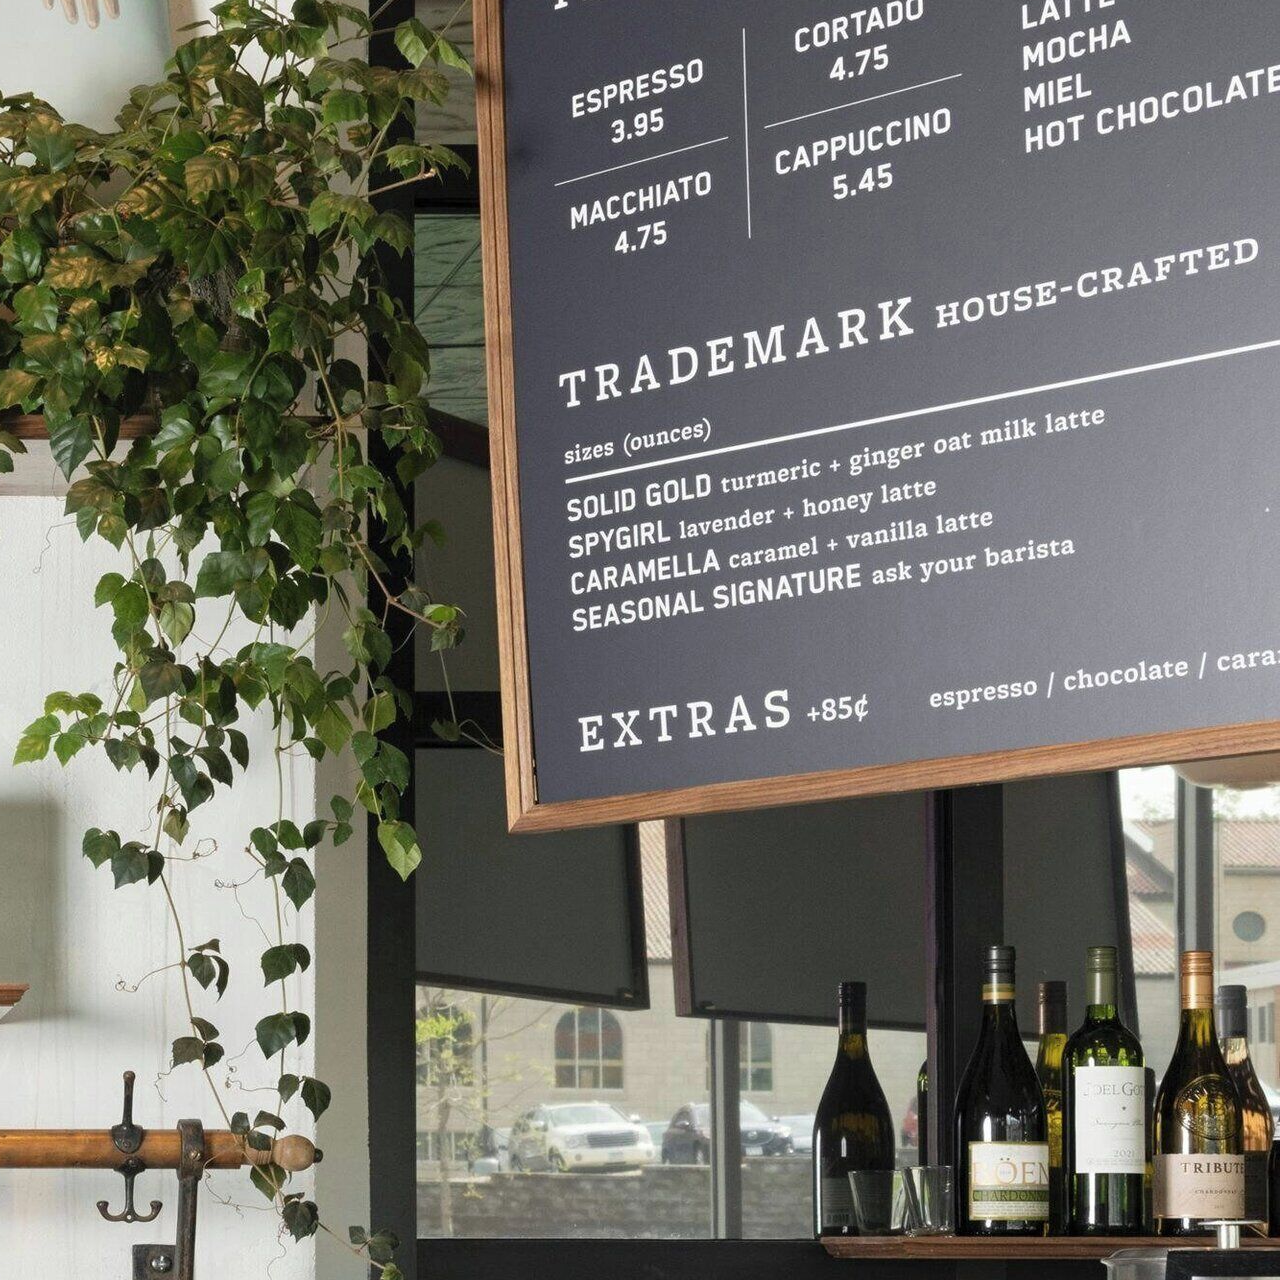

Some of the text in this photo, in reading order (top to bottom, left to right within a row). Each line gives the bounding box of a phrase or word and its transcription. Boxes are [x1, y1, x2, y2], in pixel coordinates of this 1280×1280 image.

[830, 44, 888, 80] 4.75
[1023, 20, 1131, 70] MOCHA
[572, 59, 703, 118] ESPRESSO
[1024, 73, 1091, 111] MIEL
[1025, 65, 1280, 153] HOT CHOCOLATE
[611, 108, 663, 143] 3.95
[776, 108, 950, 174] CAPPUCCINO
[571, 171, 711, 229] MACCHIATO
[833, 163, 892, 200] 5.45
[615, 221, 667, 254] 4.75
[559, 239, 1258, 408] TRADEMARK HOUSE-CRAFTED
[565, 418, 711, 464] sizes (ounces)
[567, 488, 635, 521] SOLID
[646, 474, 711, 506] GOLD
[721, 459, 820, 493] turmeric
[850, 442, 925, 476] ginger
[934, 433, 971, 453] oat
[981, 418, 1036, 445] milk
[1045, 409, 1105, 433] latte
[569, 520, 670, 558] SPYGIRL
[679, 509, 775, 538] lavender
[802, 492, 873, 517] honey
[881, 481, 936, 503] latte
[571, 549, 720, 594] CARAMELLA
[729, 536, 818, 568] caramel
[846, 520, 928, 548] vanilla
[936, 512, 993, 534] latte
[573, 540, 1075, 631] SEASONAL SIGNATURE ask your barista
[578, 689, 790, 752] EXTRAS
[807, 694, 868, 722] +85¢
[930, 681, 1037, 710] espresso
[1064, 661, 1188, 690] chocolate
[1217, 650, 1280, 671] cara
